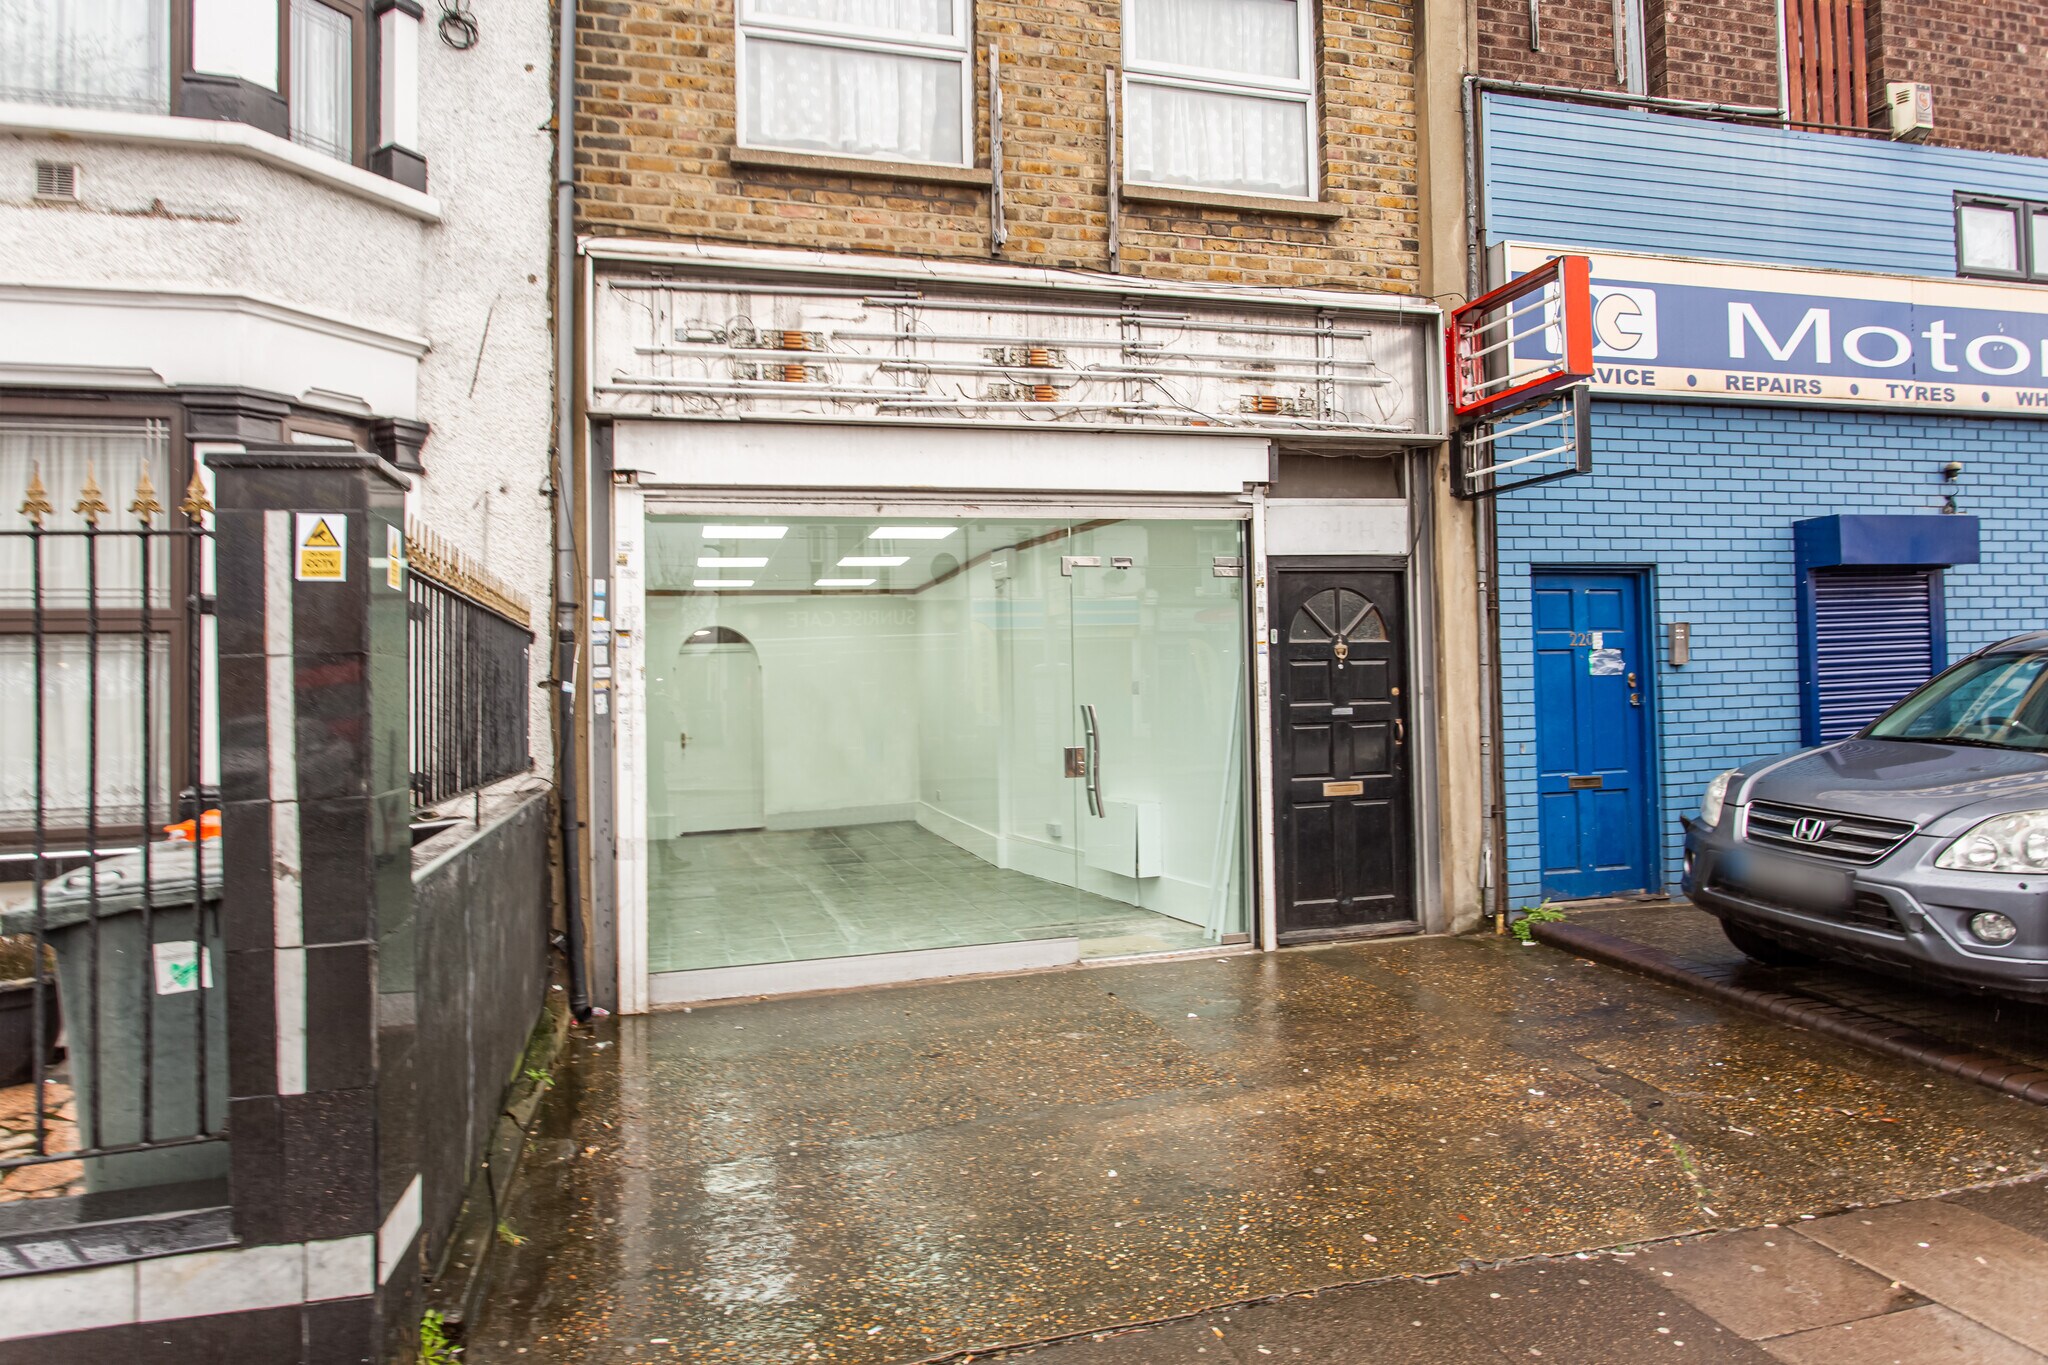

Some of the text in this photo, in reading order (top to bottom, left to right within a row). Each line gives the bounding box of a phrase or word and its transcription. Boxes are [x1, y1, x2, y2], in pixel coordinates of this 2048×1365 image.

[1547, 365, 1656, 386] RVICE
[1725, 374, 1822, 395] REPAIRS
[1885, 383, 1956, 403] TYRES
